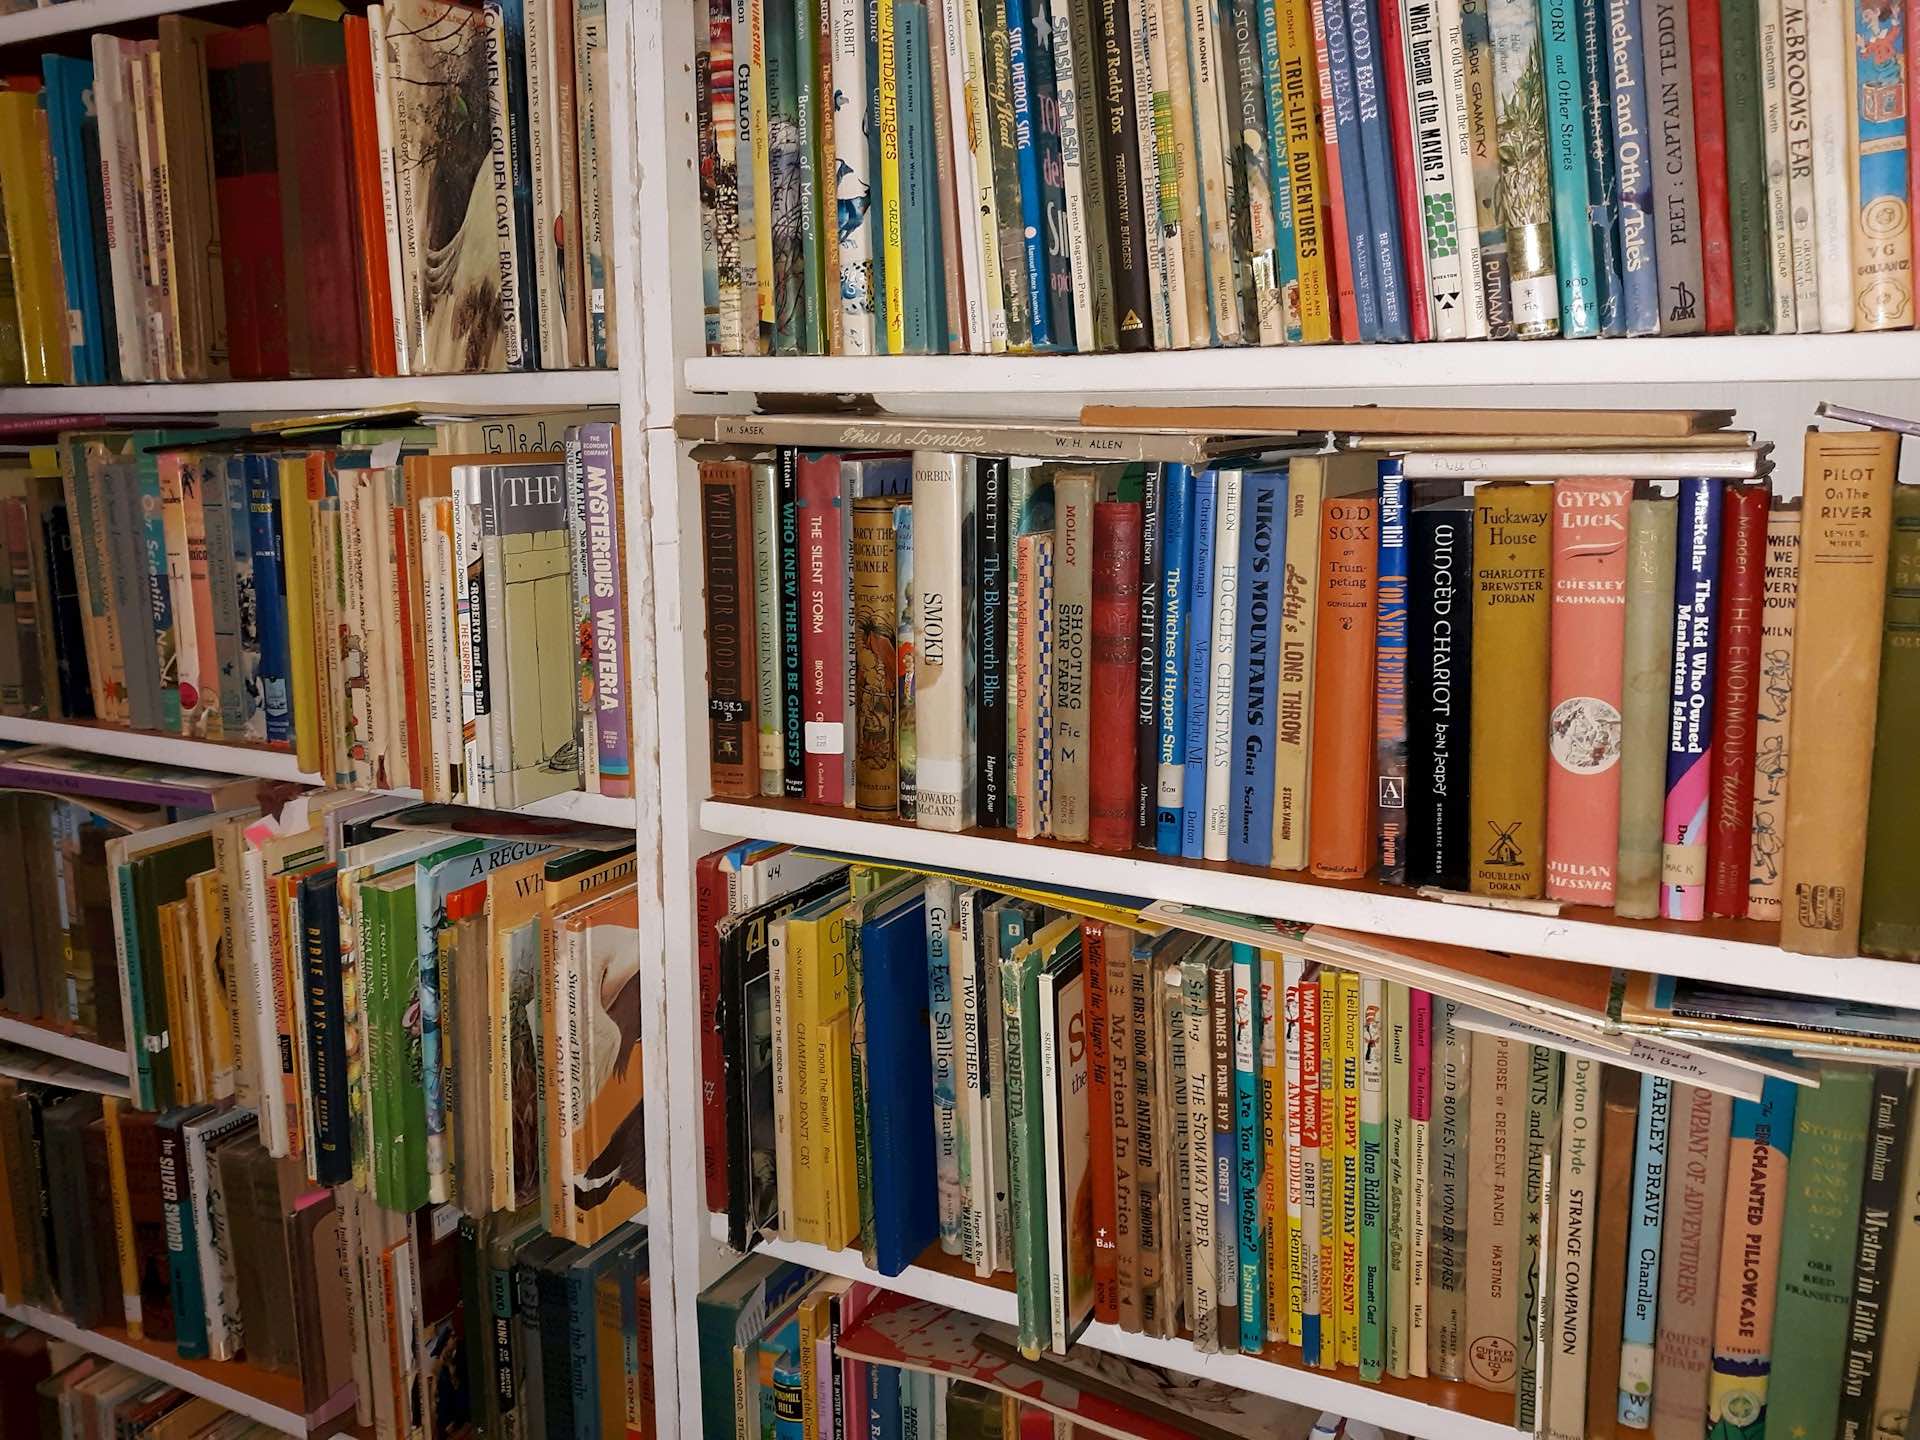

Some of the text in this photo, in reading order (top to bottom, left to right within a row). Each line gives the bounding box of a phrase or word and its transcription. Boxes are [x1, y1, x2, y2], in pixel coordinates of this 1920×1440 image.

[843, 10, 855, 56] RABBIT
[1196, 5, 1209, 83] LITTLE MONKEYS
[1409, 4, 1432, 36] What
[1657, 3, 1678, 76] TEDDY
[991, 4, 1014, 148] THE Corduroy Road
[1051, 17, 1079, 167] SPLISH SPLASH!
[1105, 40, 1123, 133] of Reddy Fox
[1232, 9, 1254, 125] STONEHENGE
[1334, 68, 1352, 126] BEAR
[1357, 66, 1377, 122] BEAR
[1412, 40, 1433, 85] became
[1416, 91, 1435, 103] of
[1764, 24, 1779, 133] Fleischman Werth
[1784, 7, 1809, 179] McBROOM'S EAR
[737, 64, 750, 141] CHALOU
[882, 5, 898, 247] AND Nimble Fingers CARLSON
[1418, 105, 1438, 124] the
[1555, 55, 1575, 170] and Other Stories
[1662, 82, 1682, 175] CAPTAIN
[482, 13, 515, 321] CARMEN GOLDEN COAST BRANDEIS
[1285, 56, 1317, 258] TRUE-LIFE ADVENTURES
[1616, 95, 1644, 272] and Other Tales
[1471, 82, 1487, 158] GRAMATKY
[1485, 261, 1501, 325] PUTNAM
[1260, 299, 1271, 330] Crowell
[1378, 233, 1398, 322] BRADBURY PRESS
[969, 300, 979, 334] Dandelion
[505, 476, 562, 507] THE
[916, 471, 950, 482] CORBIN
[1294, 495, 1304, 517] CAROL
[1381, 475, 1401, 547] Douglas Hill
[1557, 492, 1627, 507] GYPSY
[1823, 468, 1873, 480] PILOT
[783, 503, 794, 543] WHO
[1066, 505, 1075, 566] MOLLOY
[1254, 488, 1273, 572] NIKO'S
[1329, 507, 1371, 519] OLD
[1329, 528, 1369, 539] SOX
[1480, 507, 1547, 525] Tuckaway
[1489, 528, 1536, 544] House
[1561, 513, 1623, 528] LUCK
[1692, 493, 1707, 572] MacKellar
[1822, 508, 1871, 519] RIVER
[142, 494, 170, 687] Our Scientific Needs
[784, 548, 796, 595] KNEW
[811, 516, 824, 694] THE SILENT STORM BROWN
[1283, 564, 1306, 633] Lefty's
[461, 623, 472, 684] THE SURPRISE
[785, 602, 797, 668] THERE'D
[923, 593, 943, 666] SMOKE
[1058, 605, 1069, 708] STAR FARM
[1069, 605, 1082, 709] SHOOTING
[1139, 472, 1156, 826] Patricia Wrightson NIGHT OUTSIDE Atheneum
[1214, 482, 1236, 768] SHELTON HOGGLE'S CHRISTMAS
[1247, 580, 1268, 726] MOUNTAINS
[1284, 642, 1304, 682] LONG
[787, 673, 798, 689] BE
[1671, 605, 1690, 752] Manhattan Island
[1688, 580, 1709, 753] The Kid Who Owned
[787, 701, 799, 766] GHOSTS?
[1282, 690, 1302, 745] THROW
[1721, 596, 1751, 833] THE ENORMOUS turtle
[1243, 786, 1253, 844] Scribners
[306, 927, 326, 1030] BIBLE DAYS
[567, 970, 582, 1125] Swans and Wild Geese
[963, 975, 978, 1089] TWO BROTHERS
[1006, 1016, 1023, 1119] HENRIETTA
[1529, 1044, 1548, 1138] GIANTS and
[1574, 1060, 1590, 1112] Dayton
[941, 1107, 954, 1156] Martin
[1343, 988, 1357, 1314] Heilbroner THE HAPPY BIRTHDAY PRESENT
[1569, 1138, 1585, 1174] Hyde
[159, 1139, 182, 1251] the SILVER SWORD
[1567, 1189, 1583, 1257] STRANGE
[1738, 1123, 1772, 1338] ENCHANTED PILLOWCASE
[1636, 1163, 1662, 1320] BRAVE Chandler
[1677, 1162, 1705, 1306] OF ADVENTURERS
[1846, 1095, 1896, 1397] Frank Bonham Mystery in Little Tokyo
[1242, 1264, 1255, 1322] Eastman
[1562, 1261, 1580, 1354] COMPANION
[1519, 1367, 1535, 1428] MERRILL
